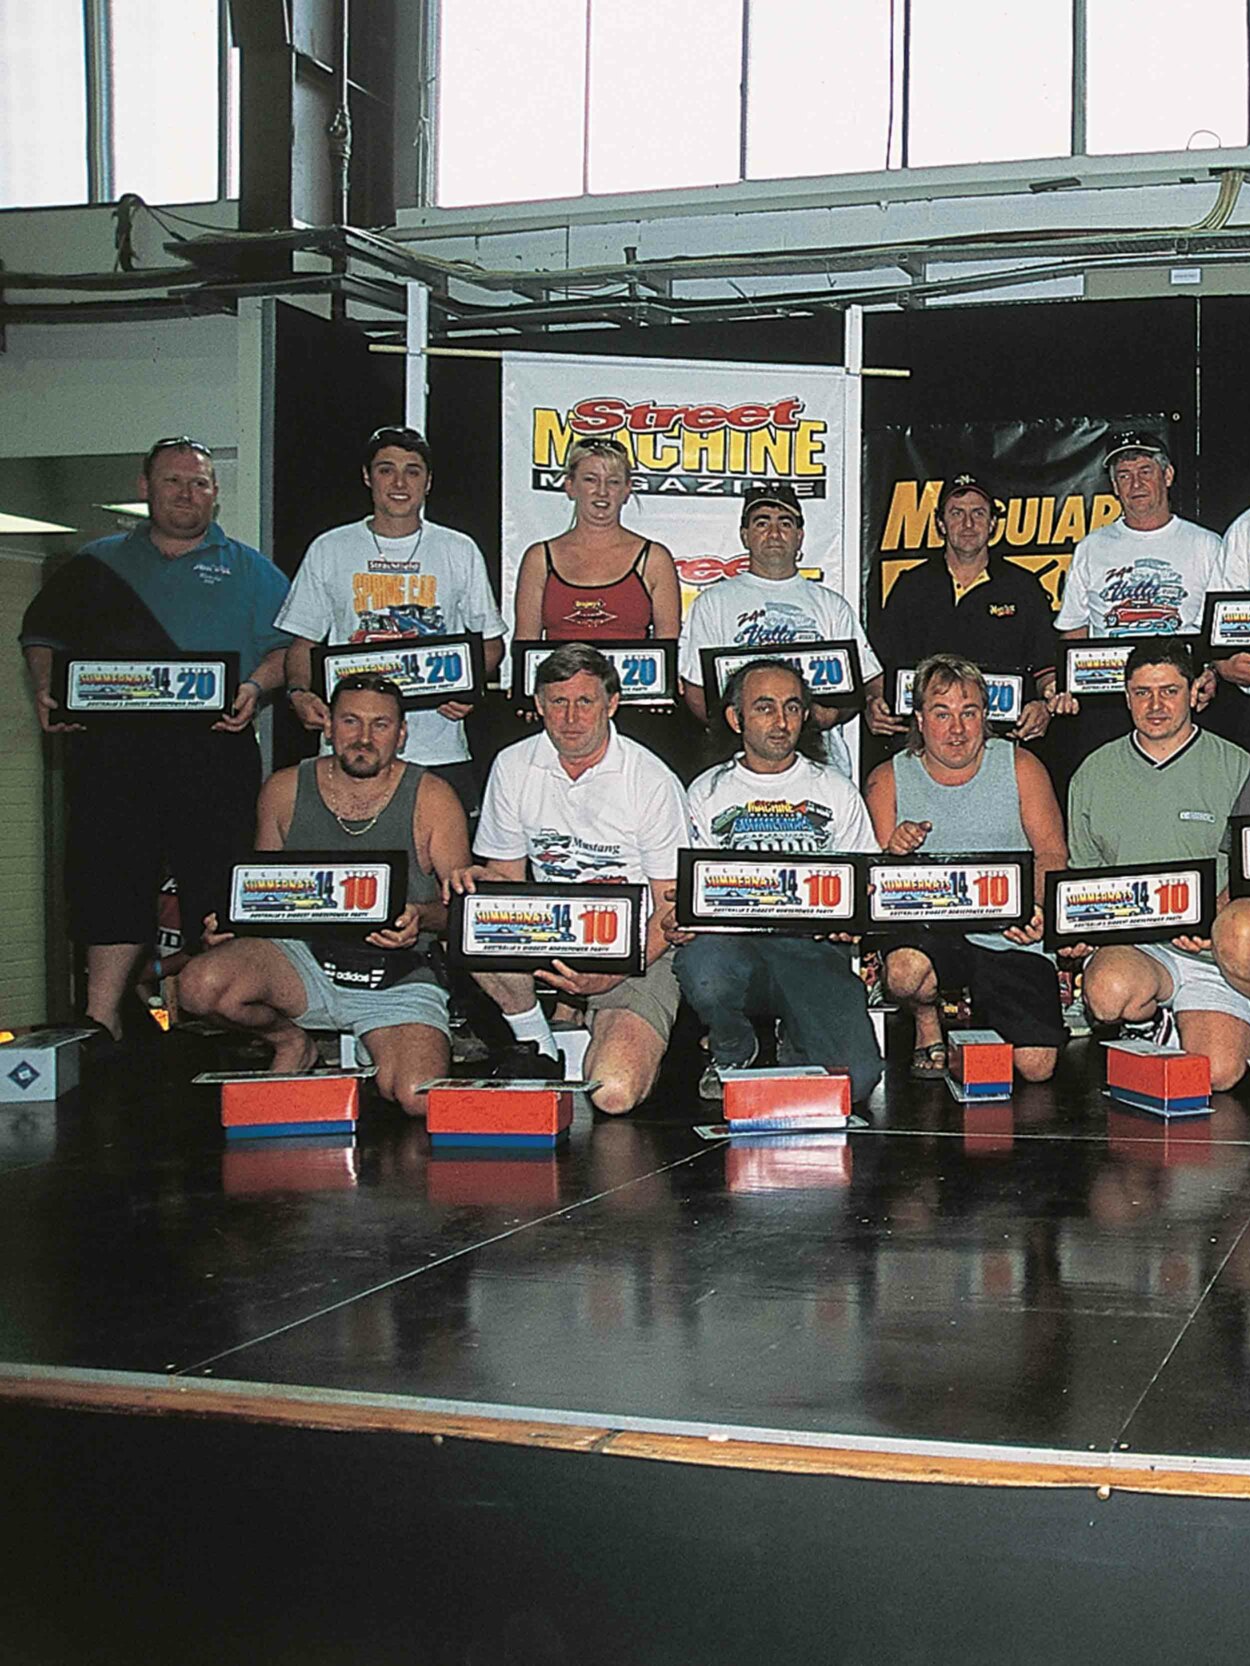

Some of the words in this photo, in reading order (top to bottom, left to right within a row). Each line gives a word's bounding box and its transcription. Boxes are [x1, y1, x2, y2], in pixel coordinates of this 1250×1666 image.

[570, 397, 805, 434] Street
[533, 408, 827, 478] MCHINE
[540, 473, 815, 497] MGAZIE
[880, 480, 1122, 551] MGUIAR
[425, 653, 463, 684] 20
[622, 657, 657, 686] 20
[809, 658, 844, 686] 20
[177, 672, 216, 700] 20
[572, 836, 621, 855] Mustang
[243, 878, 316, 893] SUMMERNATS
[340, 877, 377, 909] 10
[705, 875, 780, 889] SUMMERNATS
[804, 875, 842, 907] 10
[881, 878, 952, 893] SUMMERNATS
[974, 876, 1009, 907] 10
[1066, 889, 1133, 907] SUMMERNATS
[1155, 883, 1190, 914] 10
[475, 911, 554, 926] SUMMERNATS
[579, 910, 618, 944] 10
[337, 970, 369, 983] adidas
